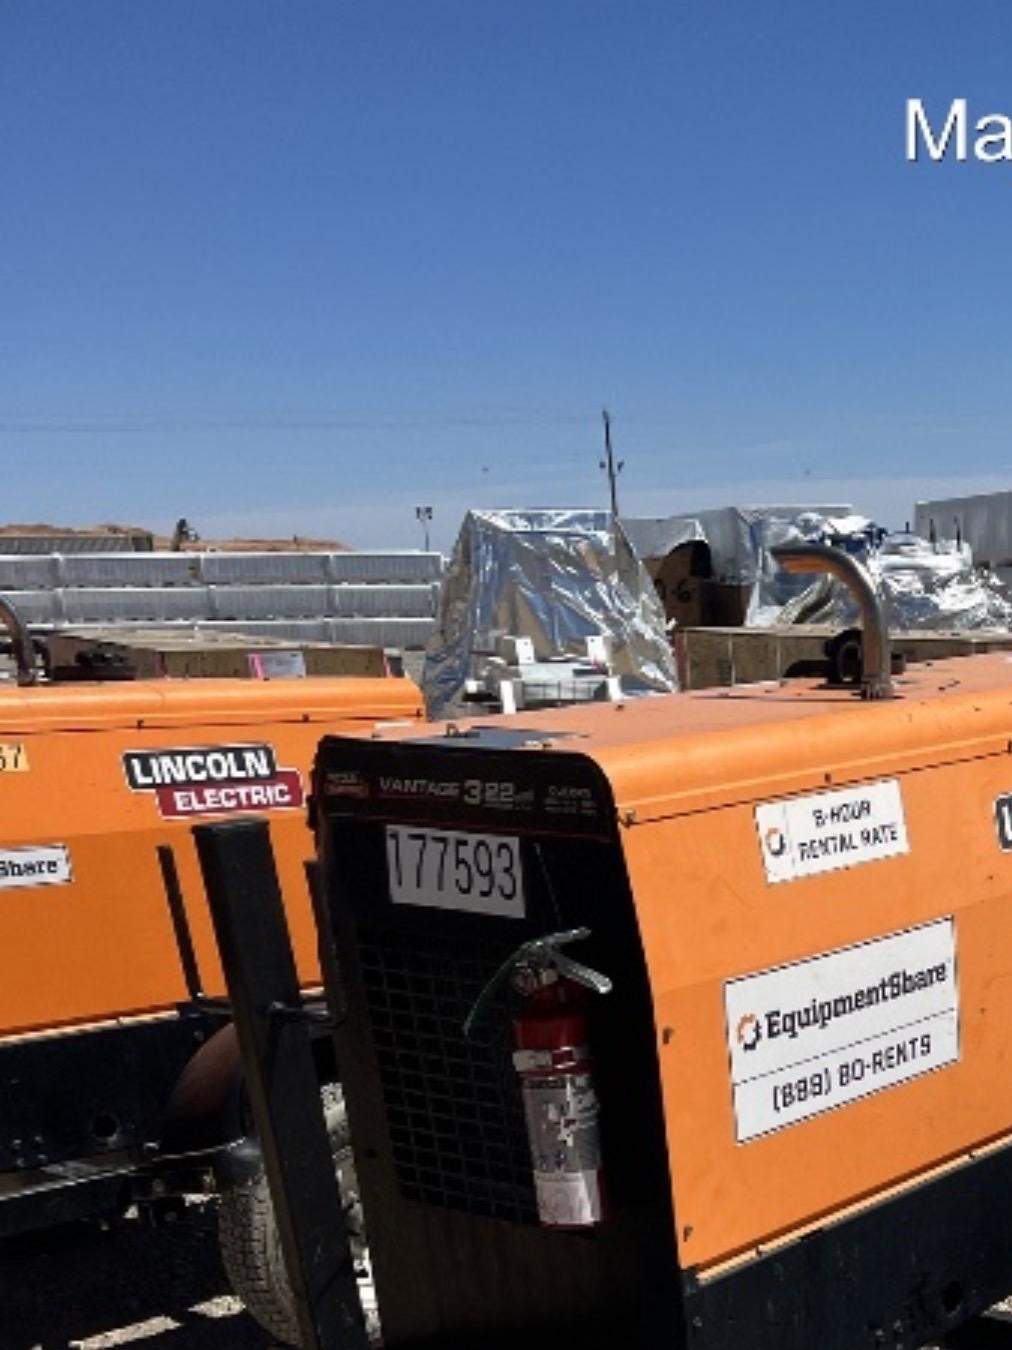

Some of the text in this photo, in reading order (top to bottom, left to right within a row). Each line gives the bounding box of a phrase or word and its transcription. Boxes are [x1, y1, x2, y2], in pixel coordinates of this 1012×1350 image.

[130, 749, 272, 785] LINCOLN
[378, 775, 461, 797] VANTAGE
[172, 784, 292, 812] ELECTRIC
[797, 822, 899, 862] RENTAL RATE
[388, 831, 518, 901] 177593
[764, 962, 947, 1040] EquipmentShare
[772, 1033, 932, 1113] (888) 80-RENTS
